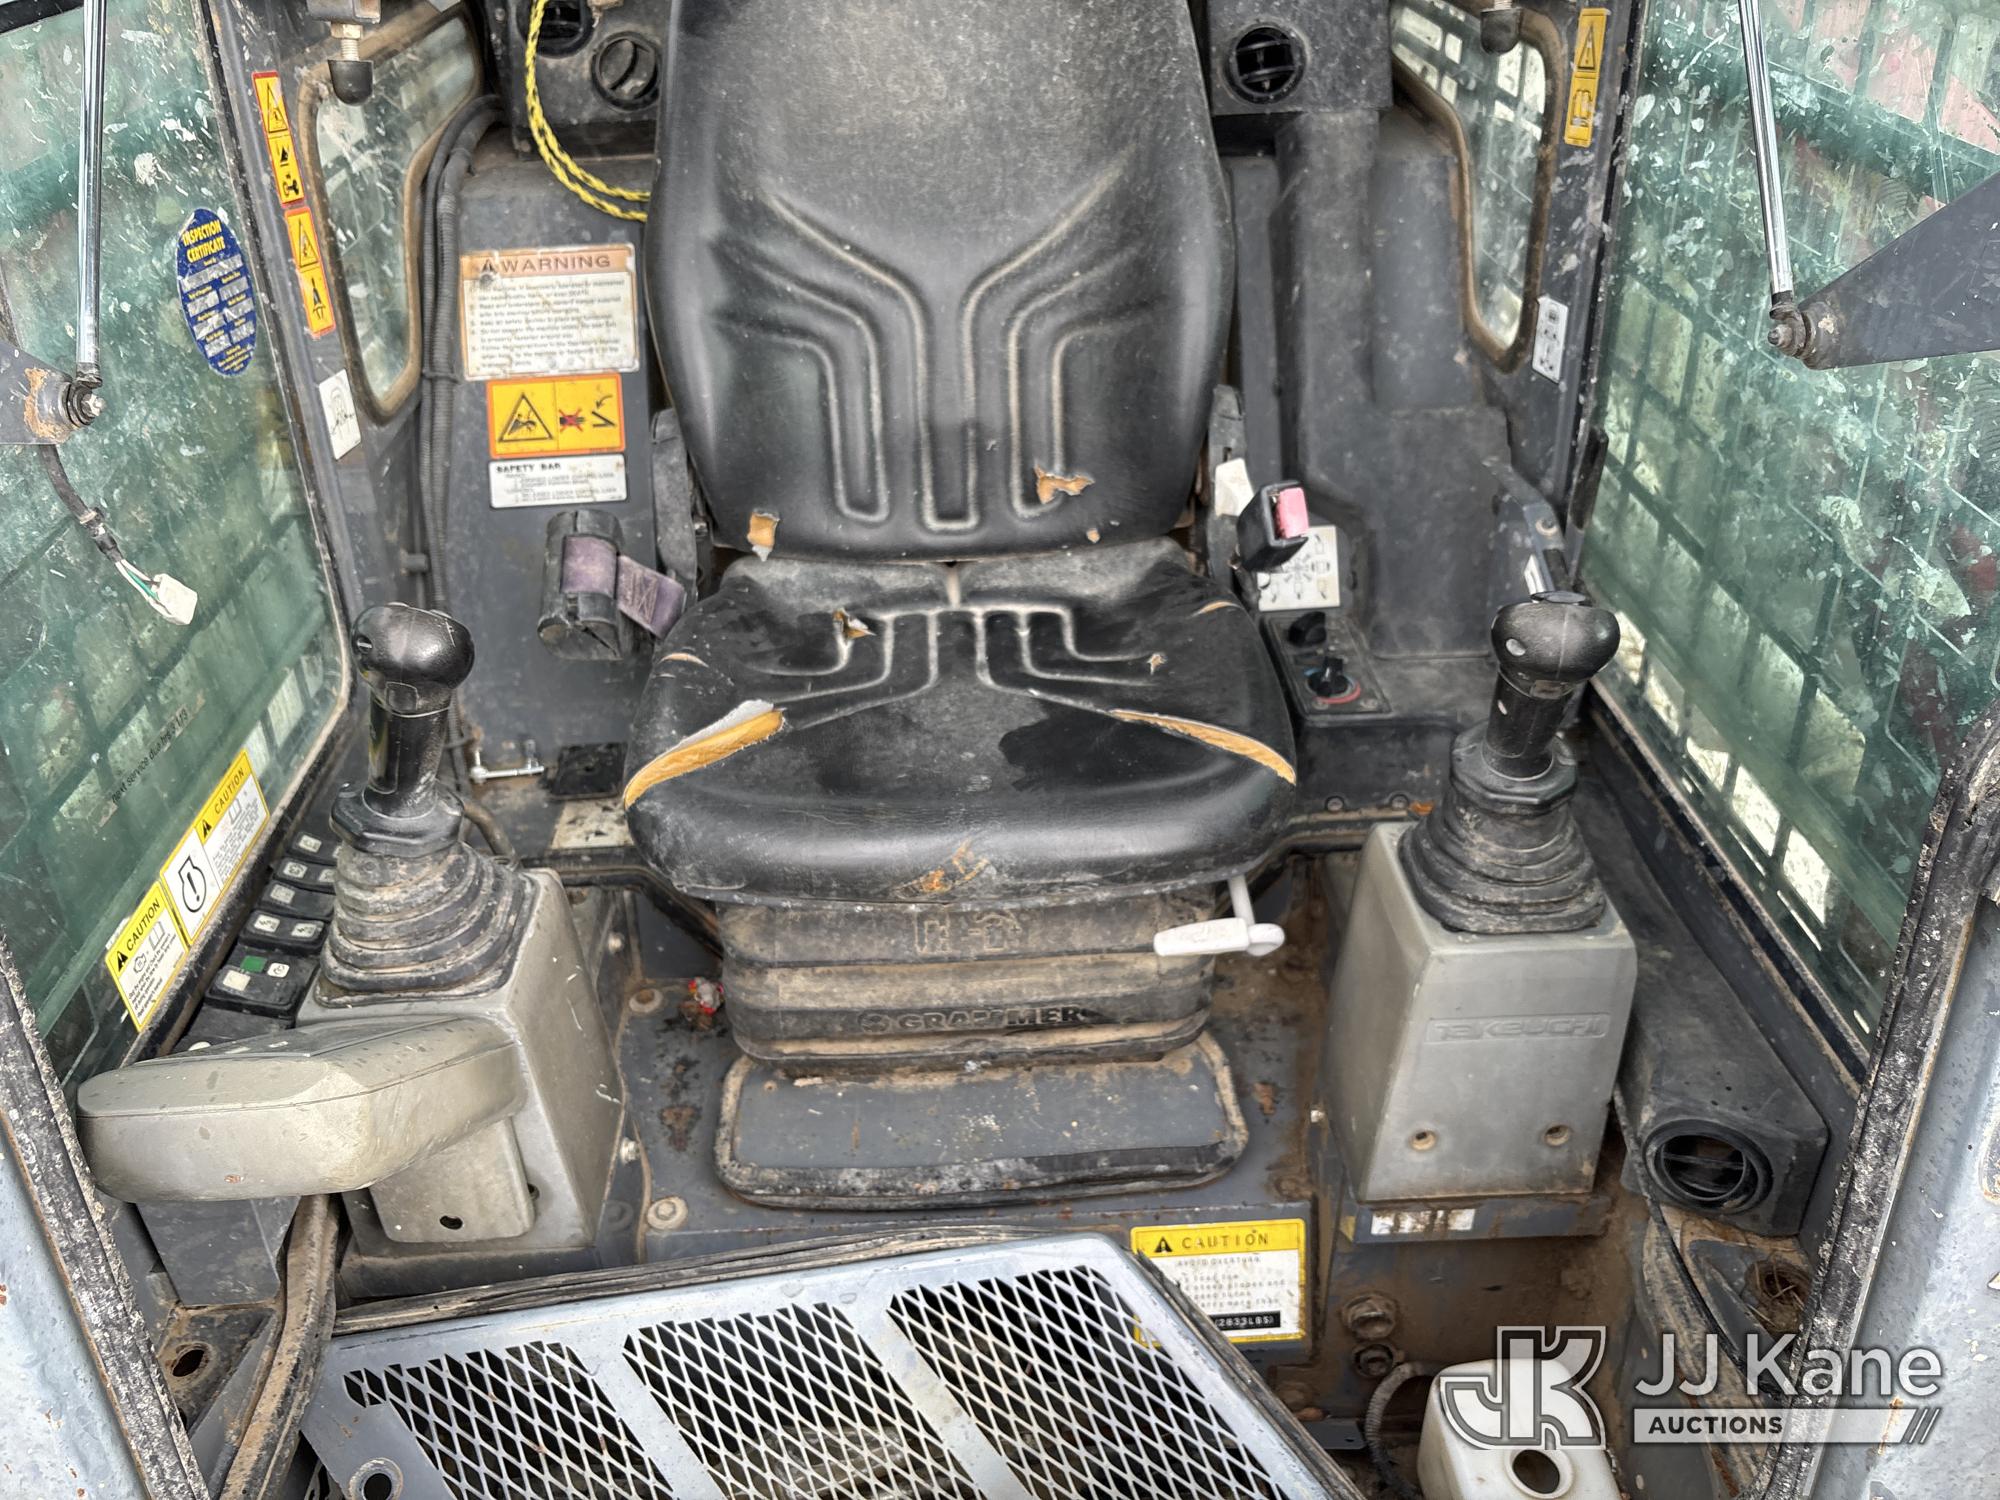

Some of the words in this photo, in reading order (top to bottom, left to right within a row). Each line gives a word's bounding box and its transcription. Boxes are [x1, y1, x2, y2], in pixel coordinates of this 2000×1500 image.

[182, 219, 222, 247] INSPECTION
[187, 236, 226, 263] CERTIFICATE
[499, 254, 611, 273] WARNING
[496, 464, 535, 474] SAFETY
[214, 767, 245, 815] CAUTION
[126, 898, 161, 952] CAUTION
[1181, 1231, 1269, 1250] CAUTION
